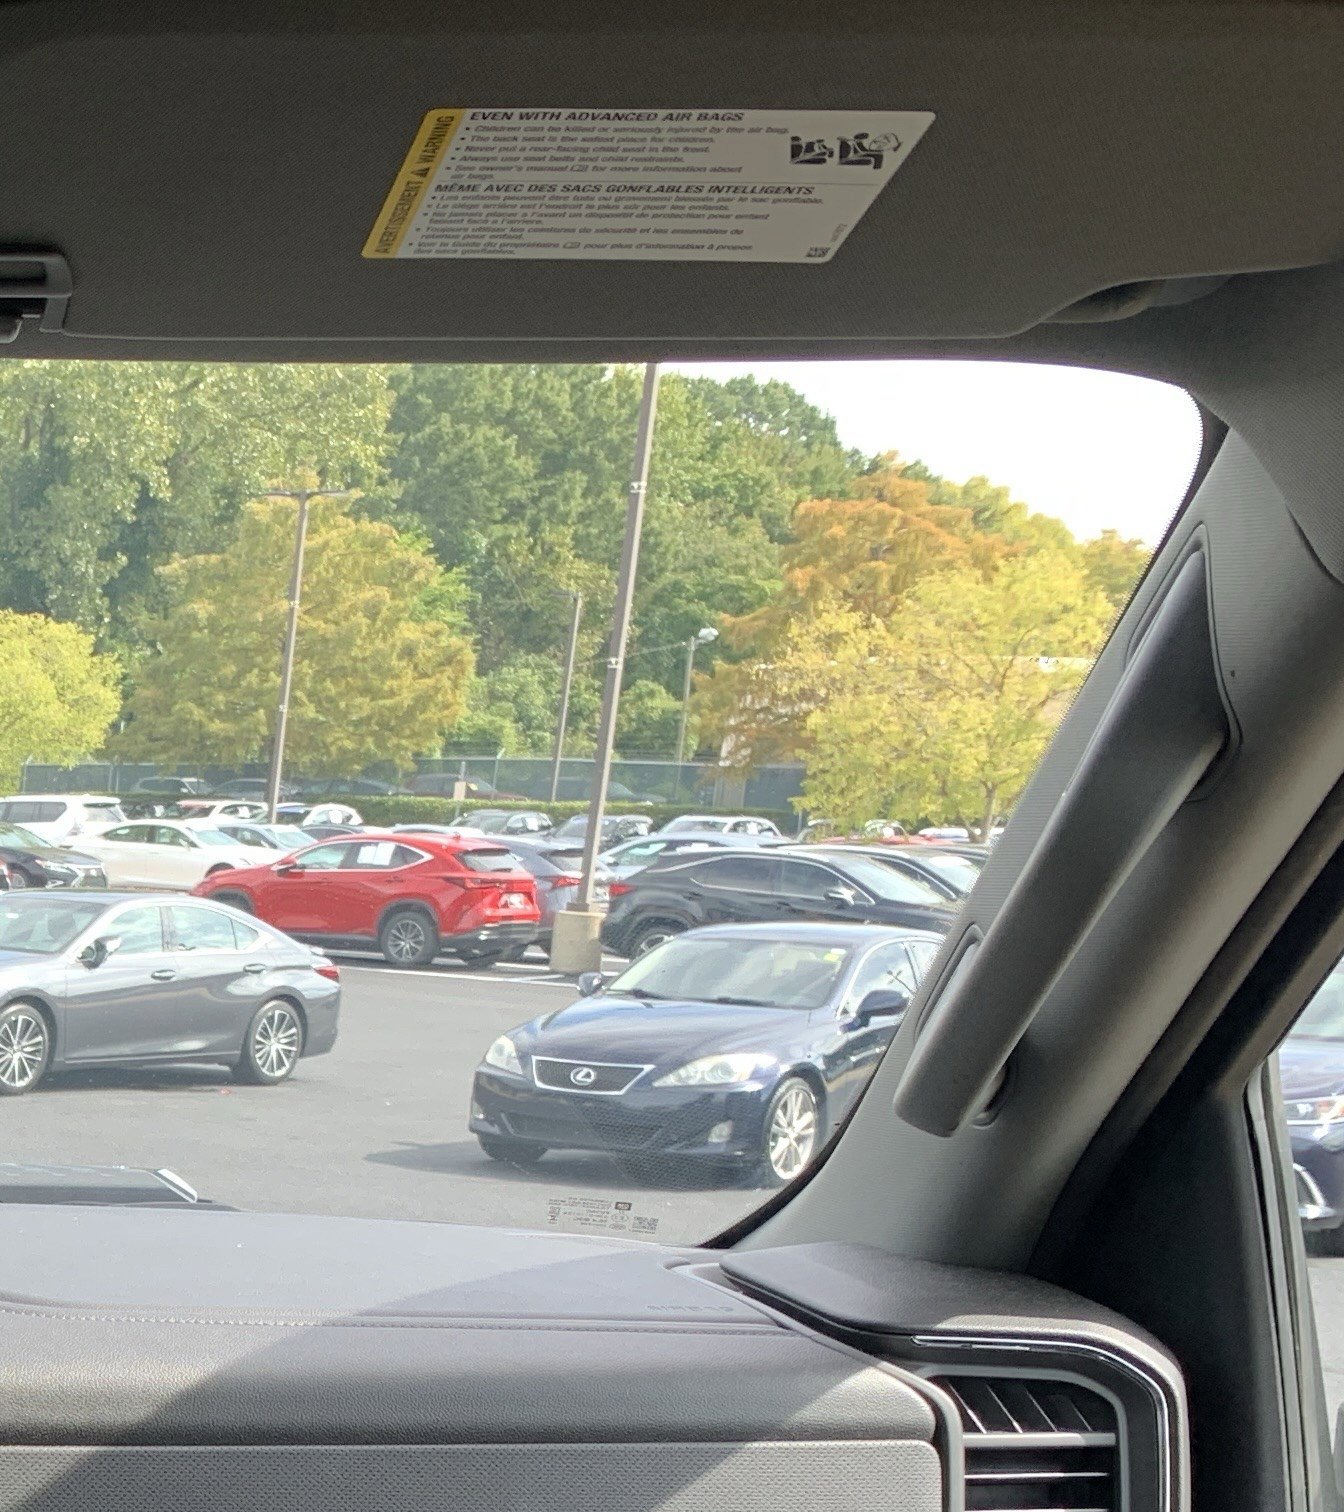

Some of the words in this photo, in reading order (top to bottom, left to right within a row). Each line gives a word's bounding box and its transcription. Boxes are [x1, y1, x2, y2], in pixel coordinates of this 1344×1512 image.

[469, 111, 514, 120] EVEN
[517, 111, 562, 120] WITH
[564, 111, 659, 120] ADVANCED
[661, 112, 694, 120] AIR
[695, 112, 746, 121] BAGS
[433, 182, 483, 192] MÊME
[483, 183, 525, 192] AVEC
[526, 183, 559, 192] DES
[559, 183, 603, 193] SACS
[605, 184, 703, 195] GONFLABLES
[708, 185, 816, 195] INTELLIGENTS
